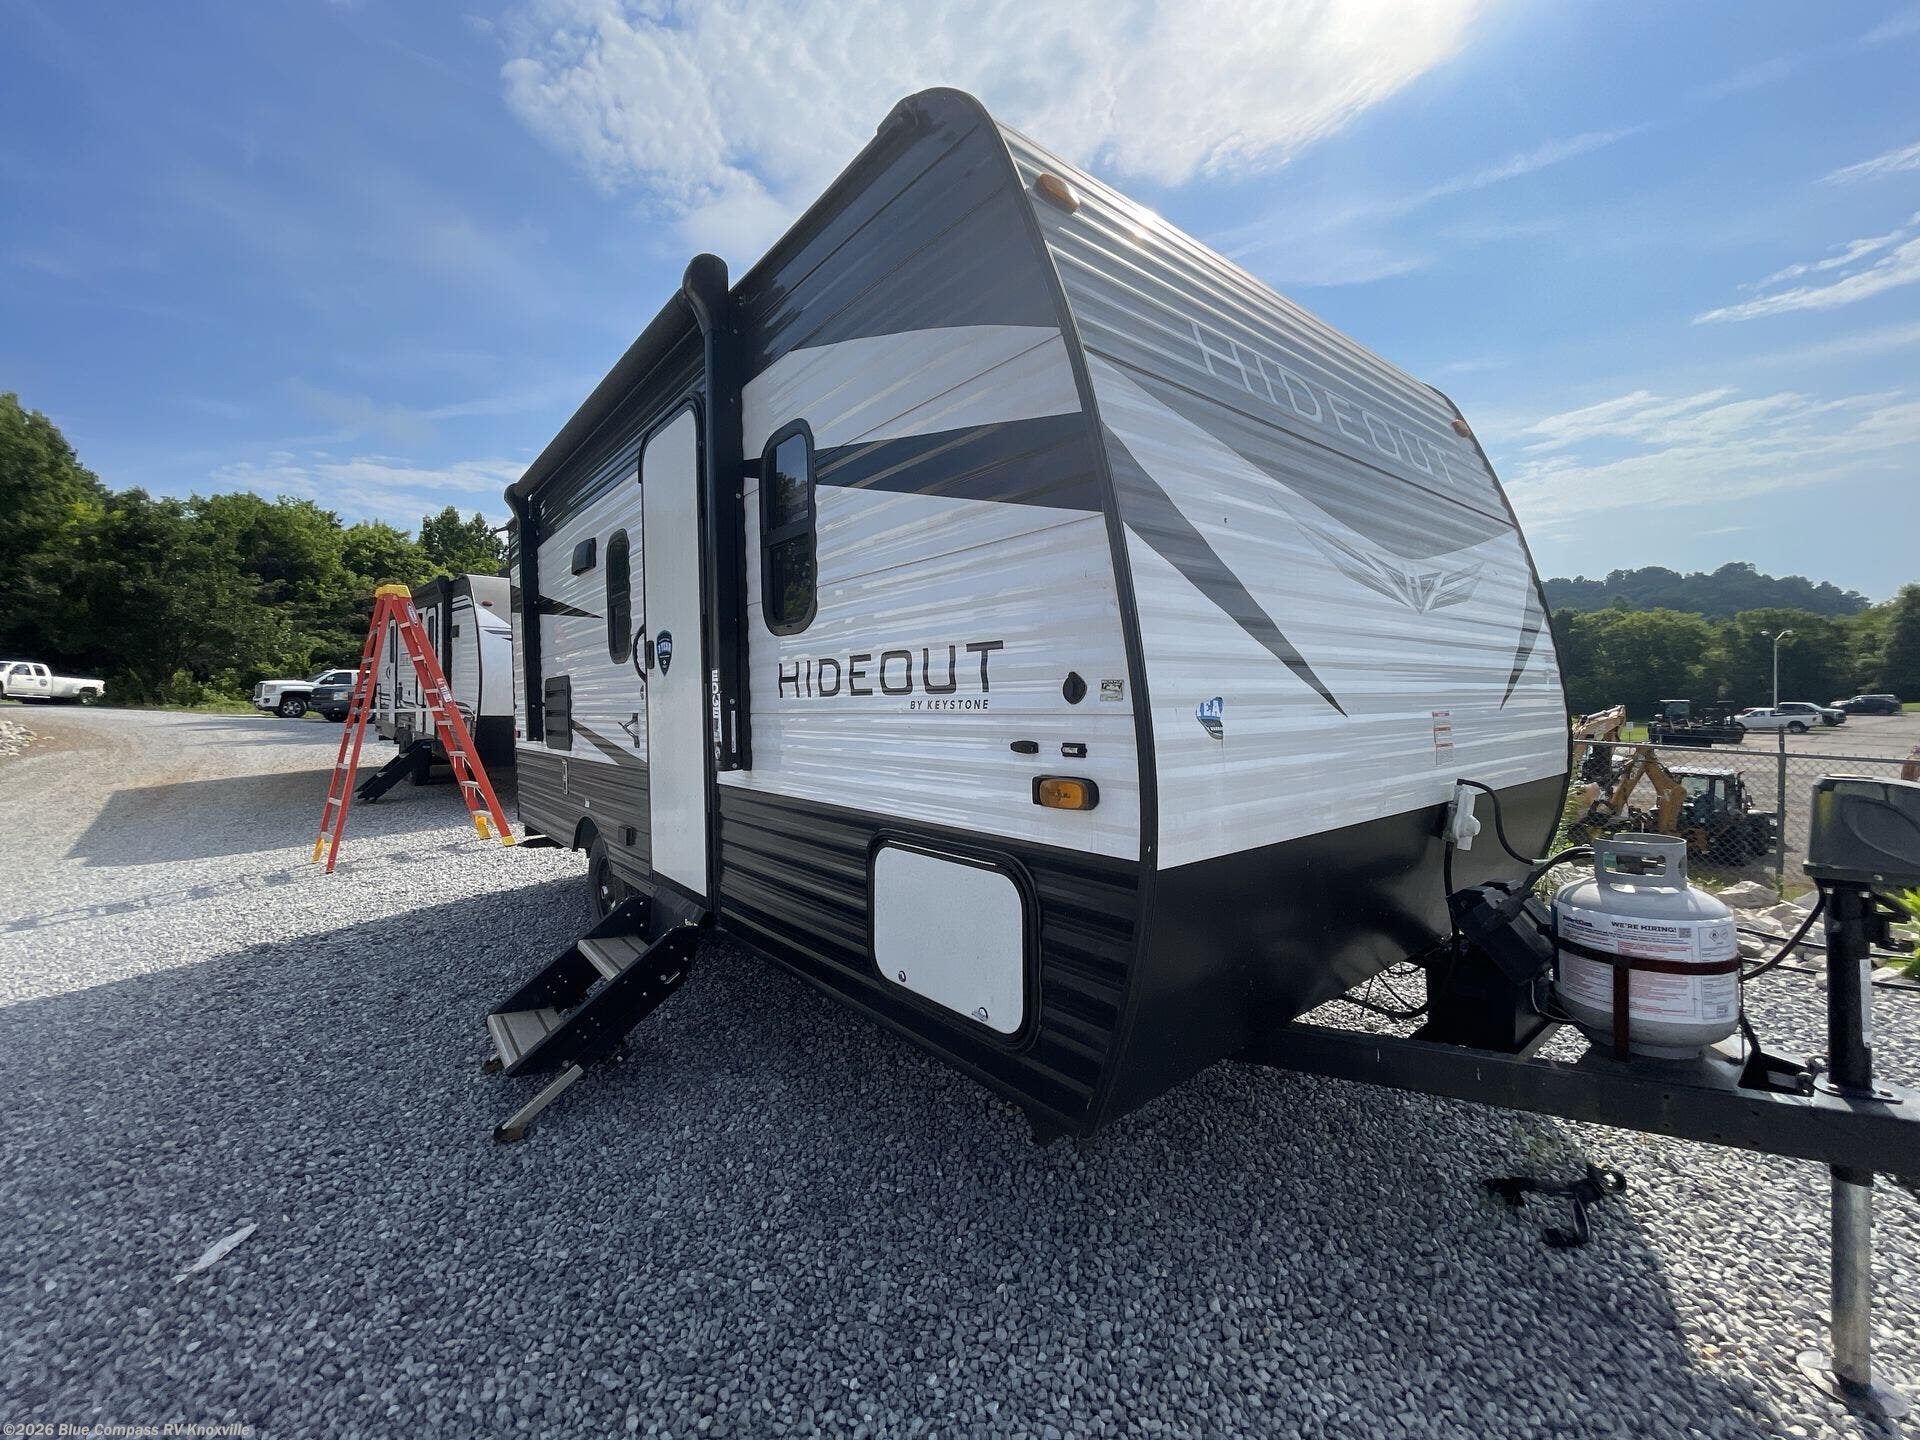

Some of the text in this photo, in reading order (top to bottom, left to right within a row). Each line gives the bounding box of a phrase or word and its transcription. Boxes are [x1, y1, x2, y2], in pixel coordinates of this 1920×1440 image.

[1191, 321, 1454, 485] HIDEOUT
[778, 640, 1004, 698] HIDEOUT
[910, 700, 989, 710] BY KEYSTONE
[1611, 921, 1677, 933] WE'RE HIRING!
